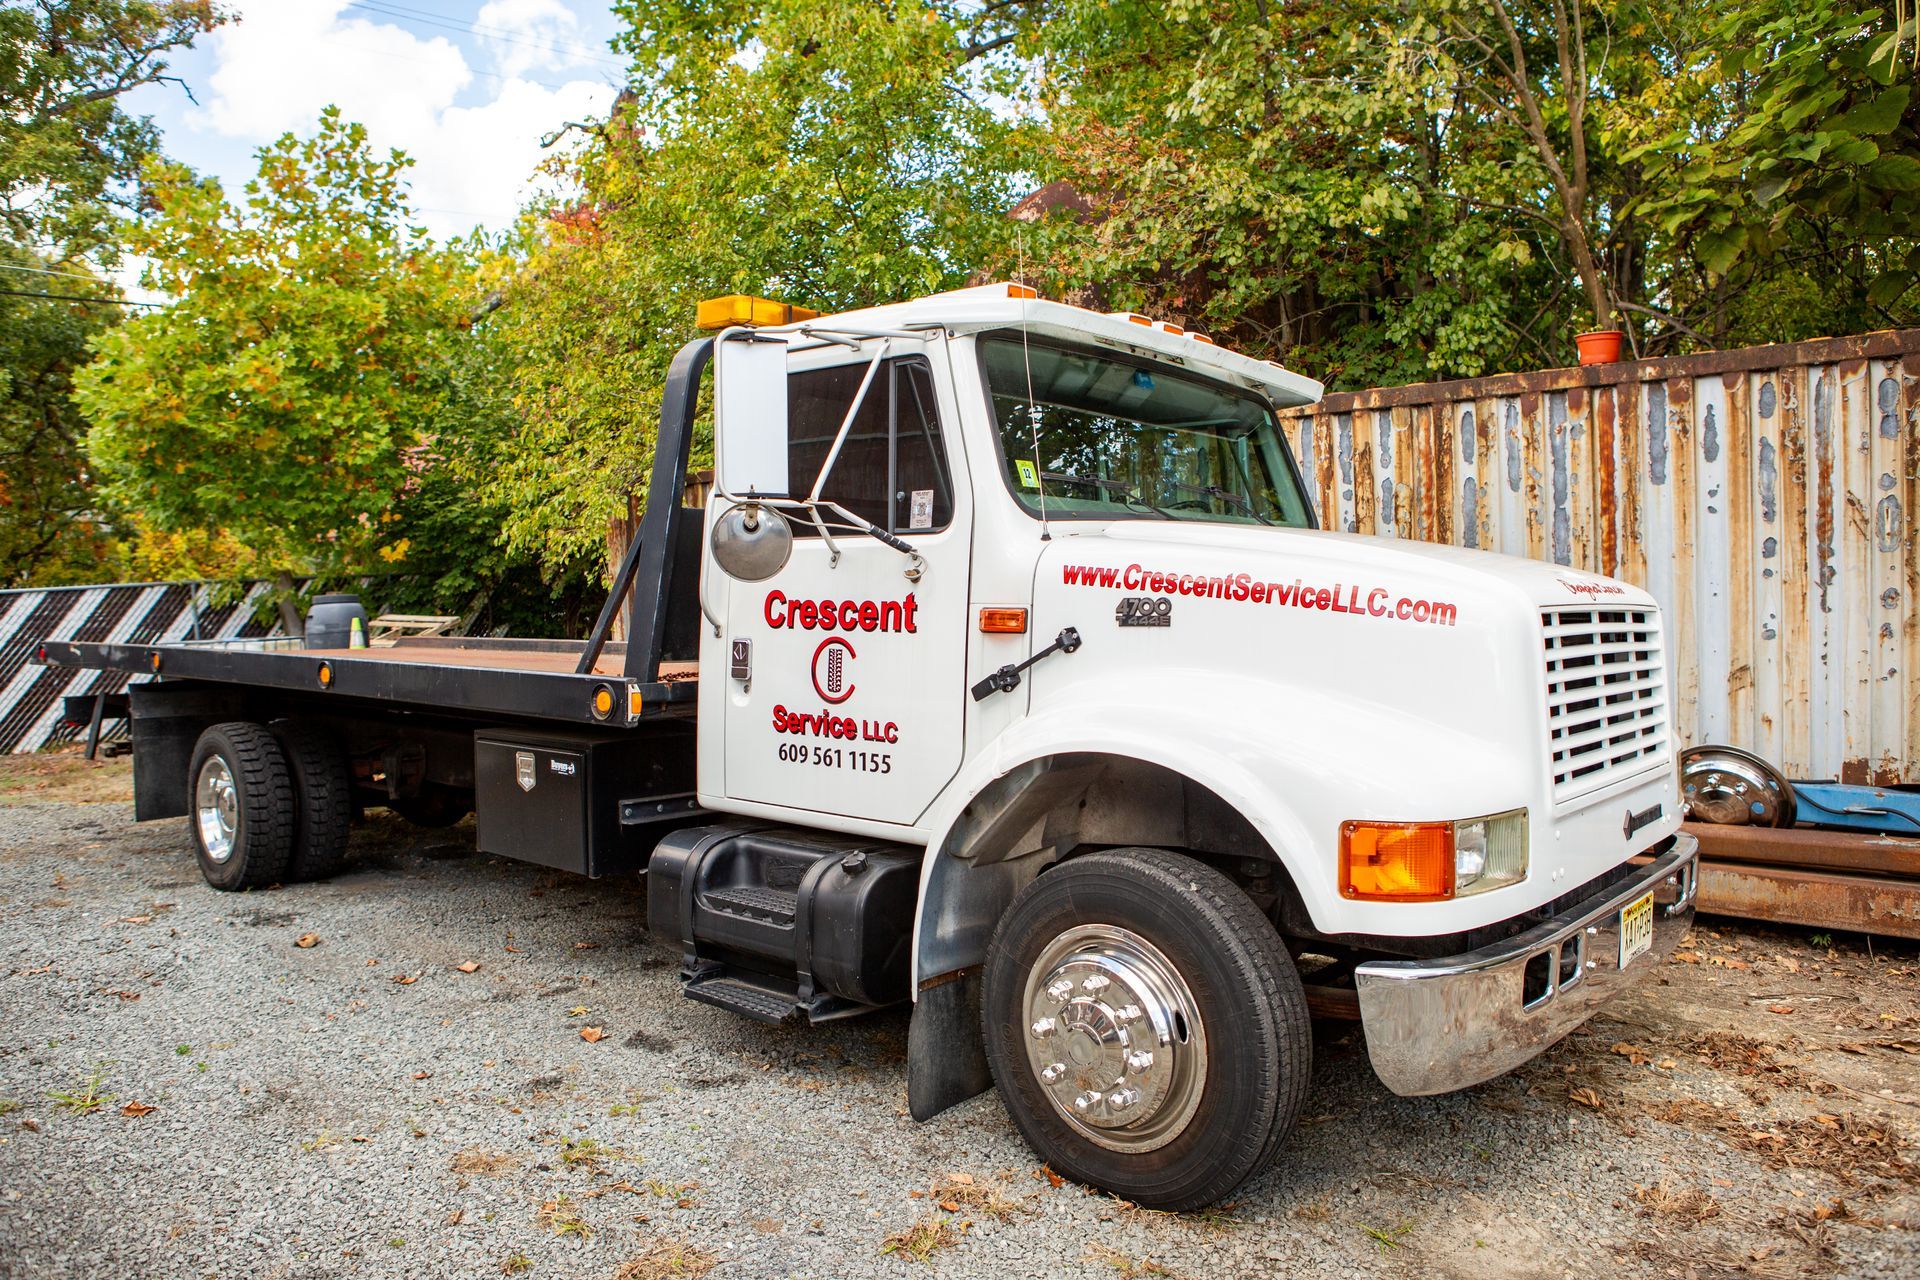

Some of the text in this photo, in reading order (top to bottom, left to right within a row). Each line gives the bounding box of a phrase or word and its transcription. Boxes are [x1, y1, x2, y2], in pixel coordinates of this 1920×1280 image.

[764, 589, 919, 634] Crescent
[1062, 562, 1458, 627] www.CrescentServiceLLC.com
[1115, 597, 1172, 616] 4700
[772, 704, 899, 744] Service LLC
[778, 743, 891, 774] 609 561 1155
